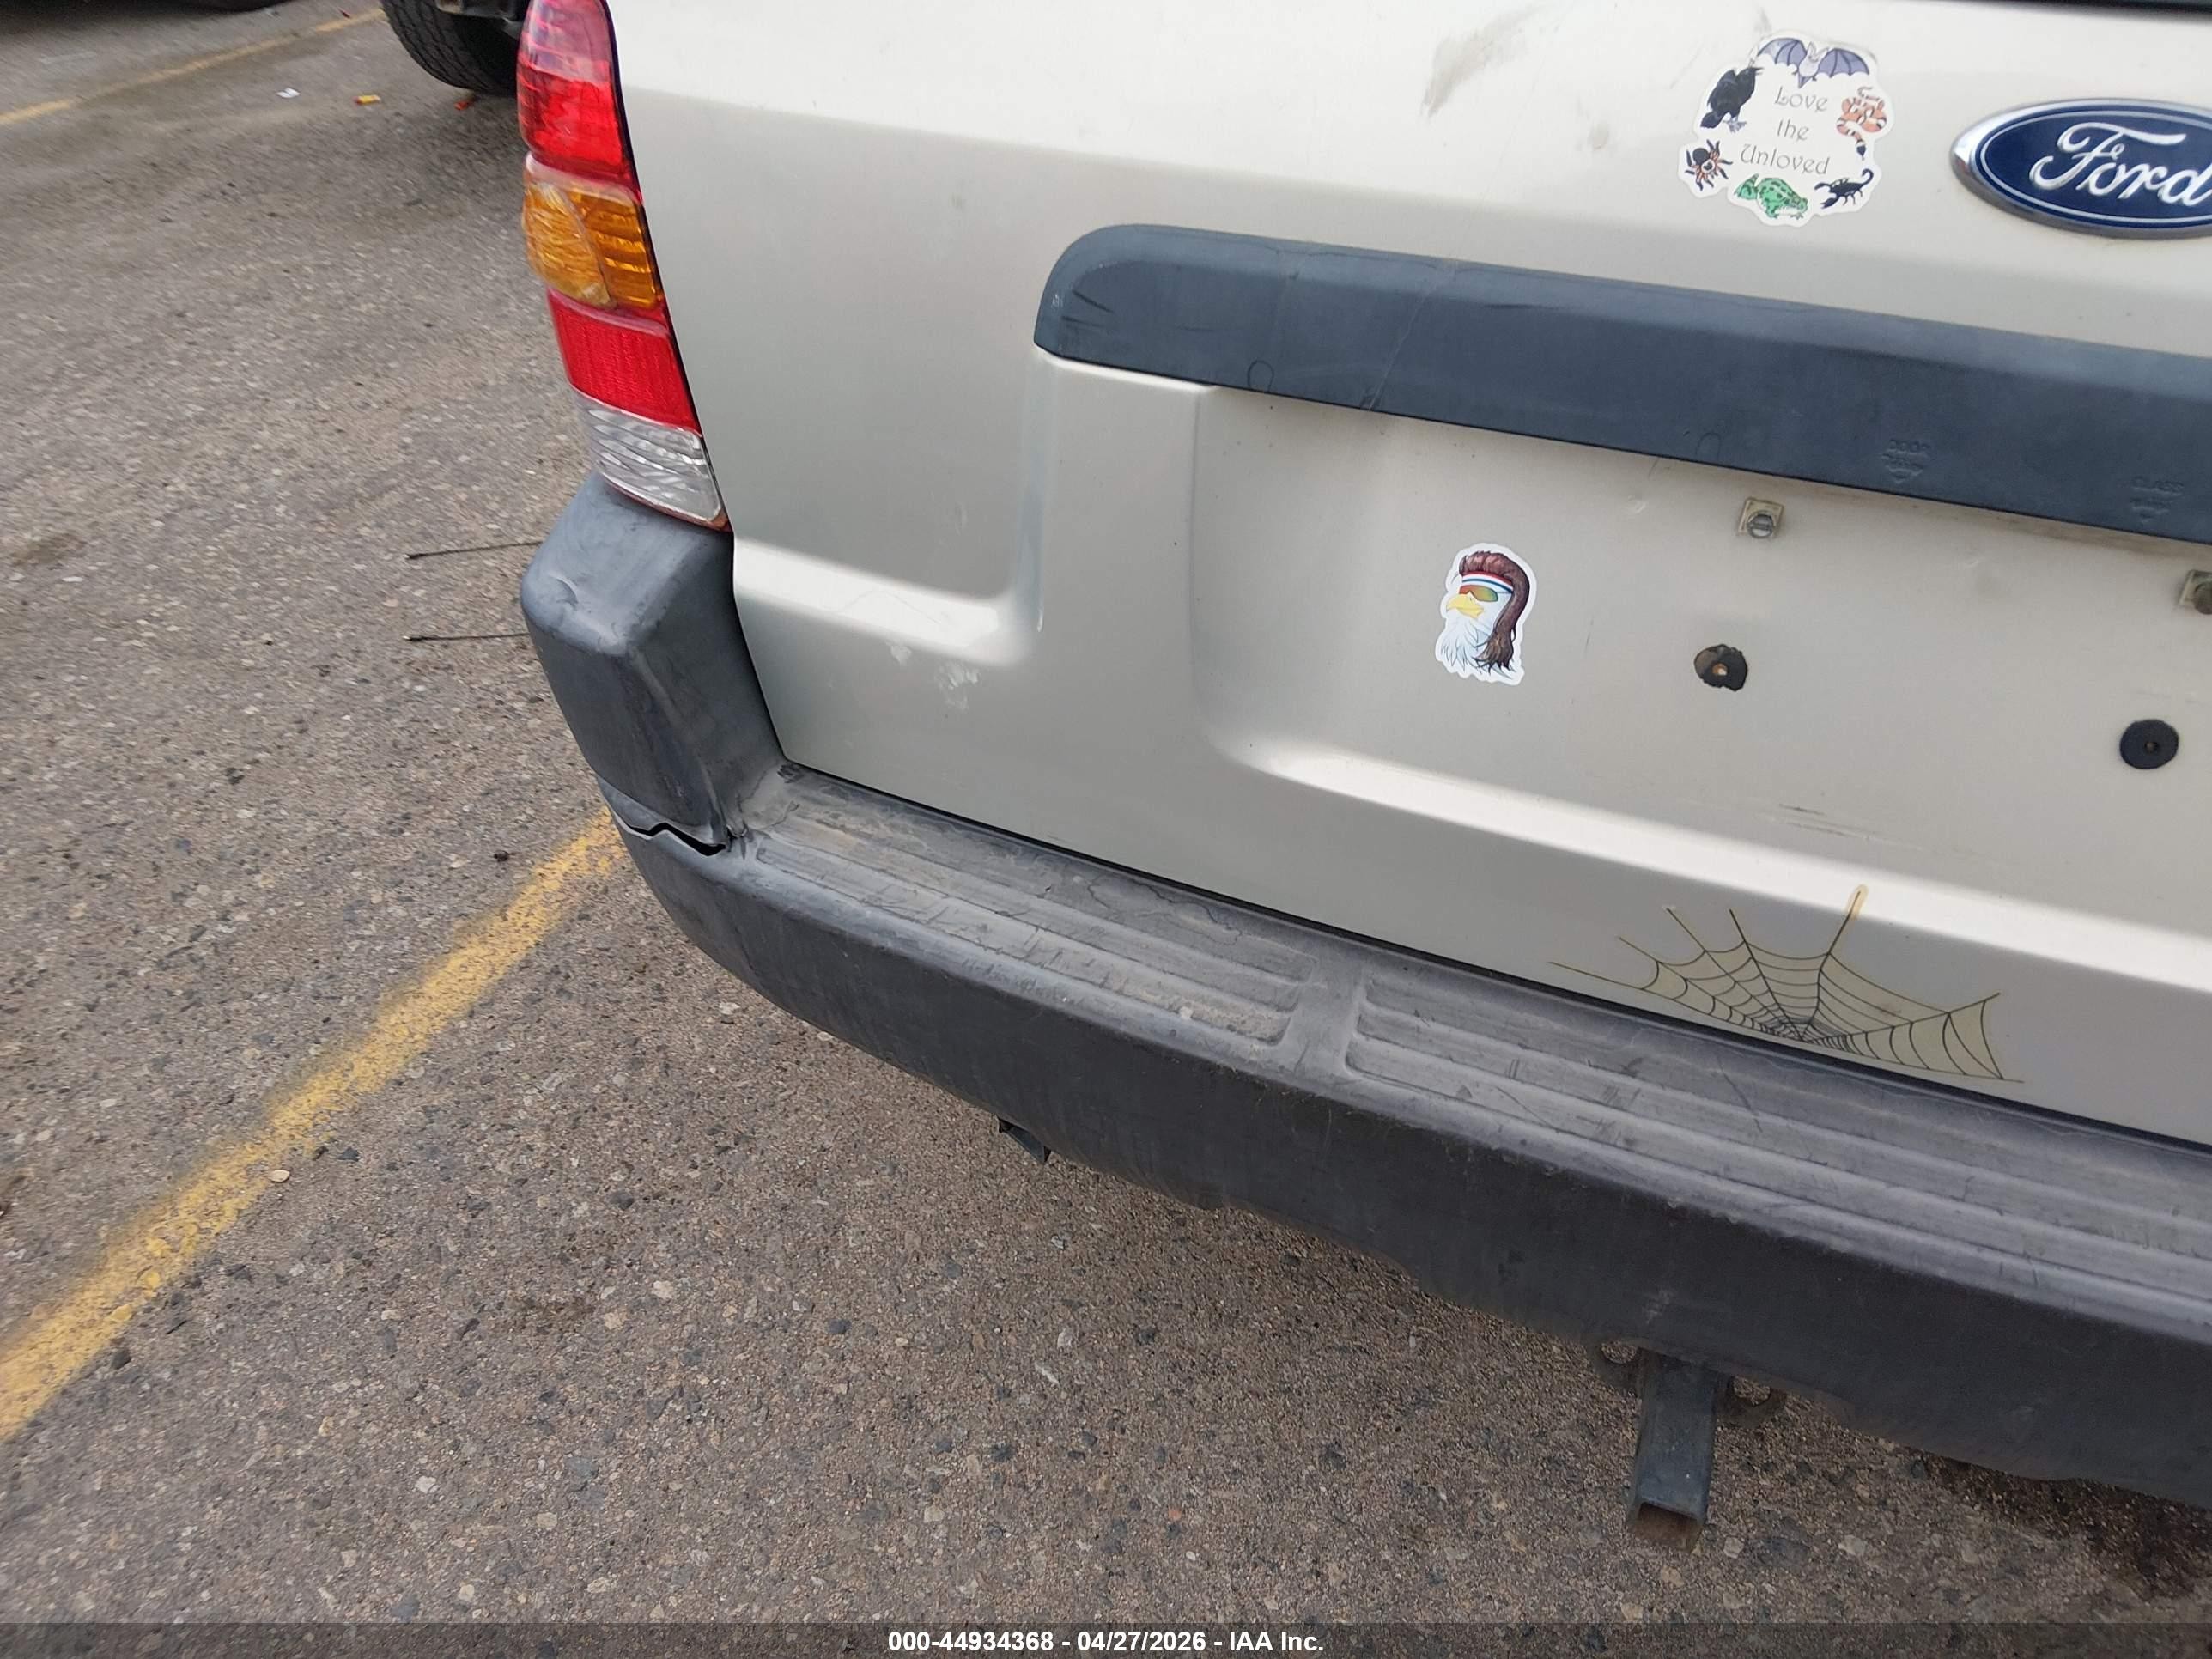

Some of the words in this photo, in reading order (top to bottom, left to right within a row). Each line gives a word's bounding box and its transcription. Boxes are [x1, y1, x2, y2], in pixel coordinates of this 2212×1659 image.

[1774, 86, 1828, 112] Love
[1777, 118, 1810, 141] the
[1740, 143, 1831, 175] Unloved
